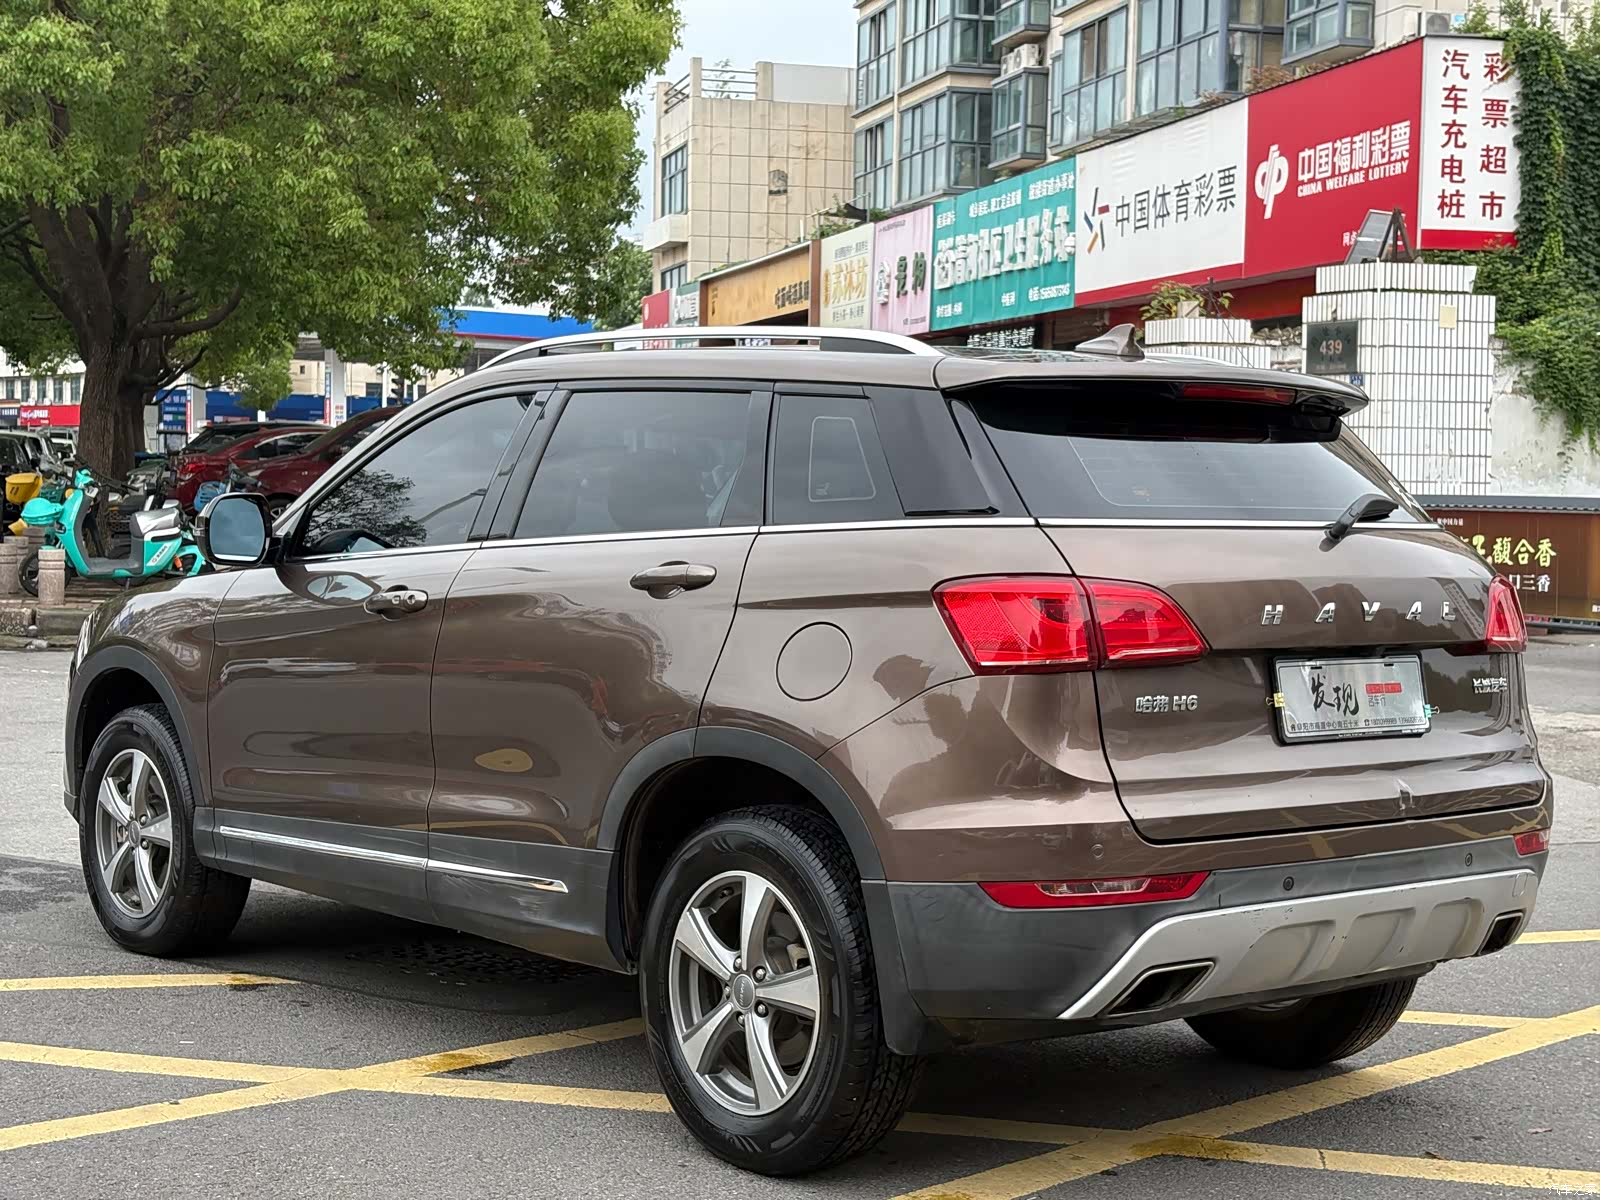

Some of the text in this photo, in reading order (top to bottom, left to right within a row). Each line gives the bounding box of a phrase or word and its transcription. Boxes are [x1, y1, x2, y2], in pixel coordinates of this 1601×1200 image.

[1297, 120, 1411, 182] 中国福利彩票
[1437, 49, 1470, 220] 汽车充电桩
[1479, 52, 1510, 221] 彩票超市
[1297, 160, 1409, 197] CHINA WELFARE LOTTERY
[1115, 165, 1237, 237] 中国体育彩票
[1320, 340, 1343, 354] 439
[1261, 601, 1457, 625] HAVAL
[1135, 694, 1198, 714] 哈弗 H6
[1310, 673, 1360, 716] 发现
